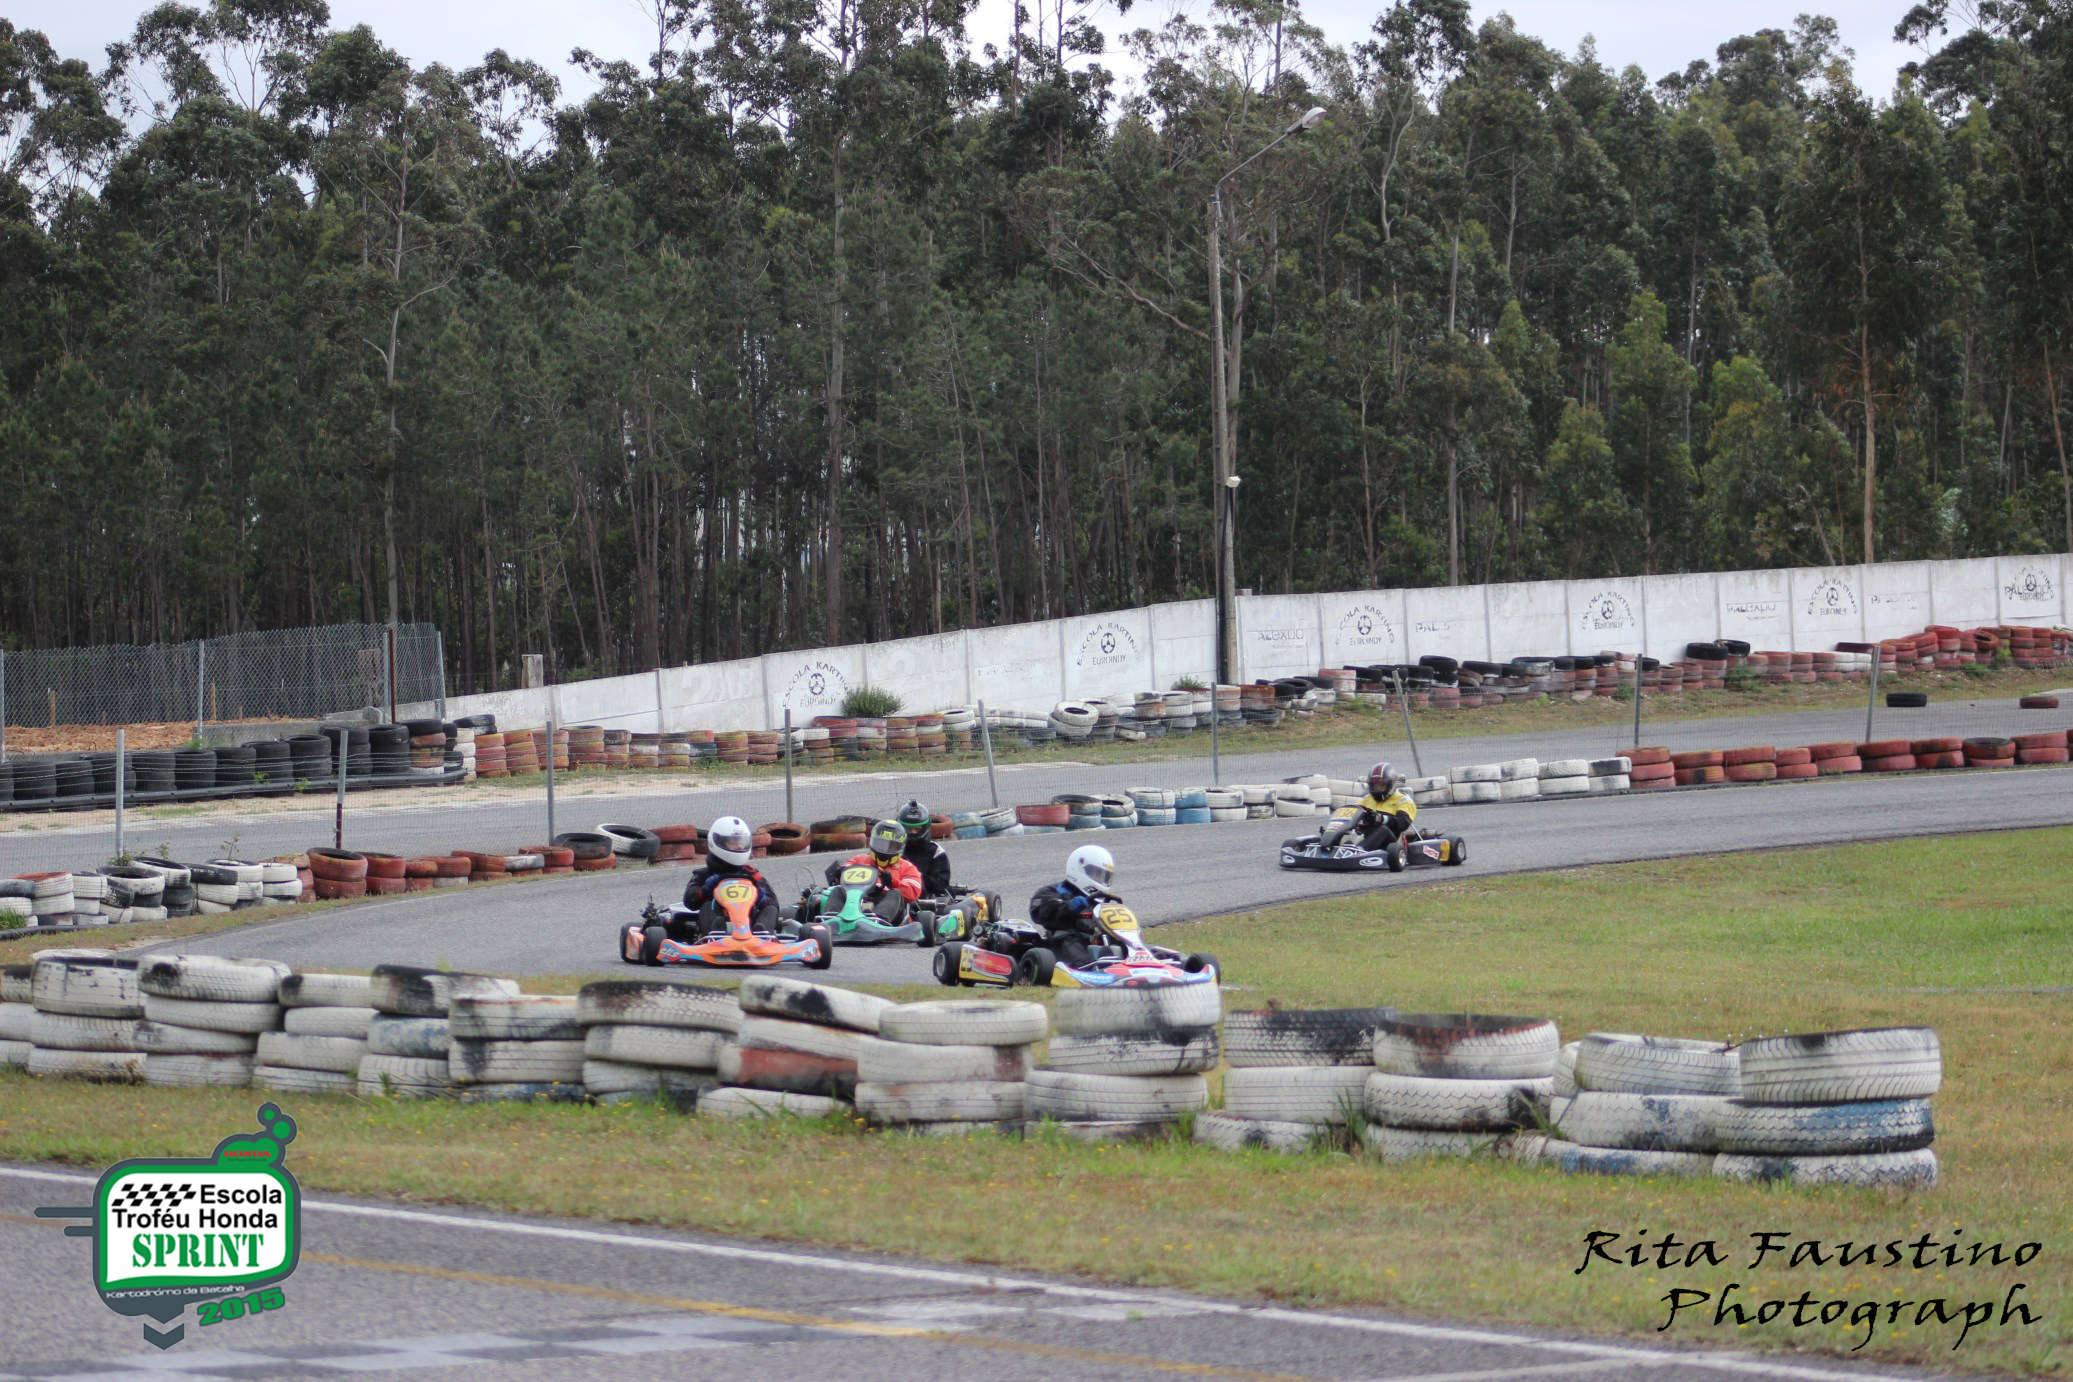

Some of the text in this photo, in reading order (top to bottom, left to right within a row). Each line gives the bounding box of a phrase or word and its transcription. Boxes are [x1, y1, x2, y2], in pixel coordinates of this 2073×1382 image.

[846, 870, 867, 880] 74
[725, 885, 751, 899] 67
[1102, 907, 1133, 925] 25
